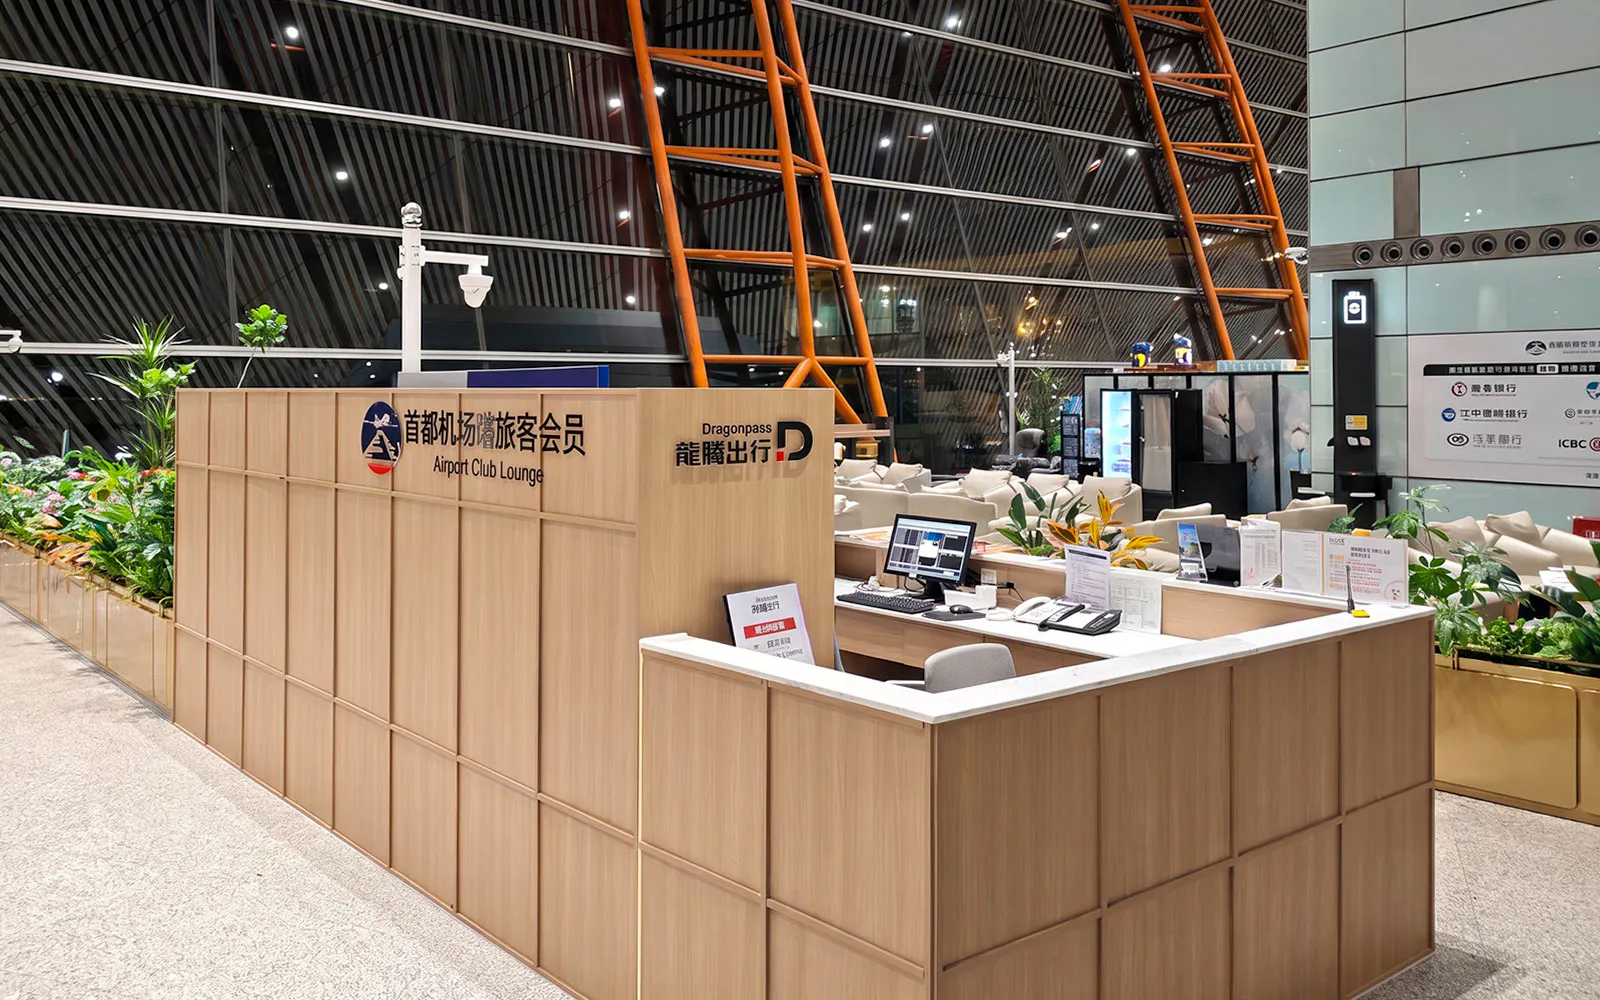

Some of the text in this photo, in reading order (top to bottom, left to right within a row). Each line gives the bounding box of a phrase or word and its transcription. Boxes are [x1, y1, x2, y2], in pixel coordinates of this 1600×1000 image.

[702, 423, 772, 437] Dragonpass
[1558, 439, 1587, 449] ICBC
[433, 456, 544, 487] Airport Club Lounge
